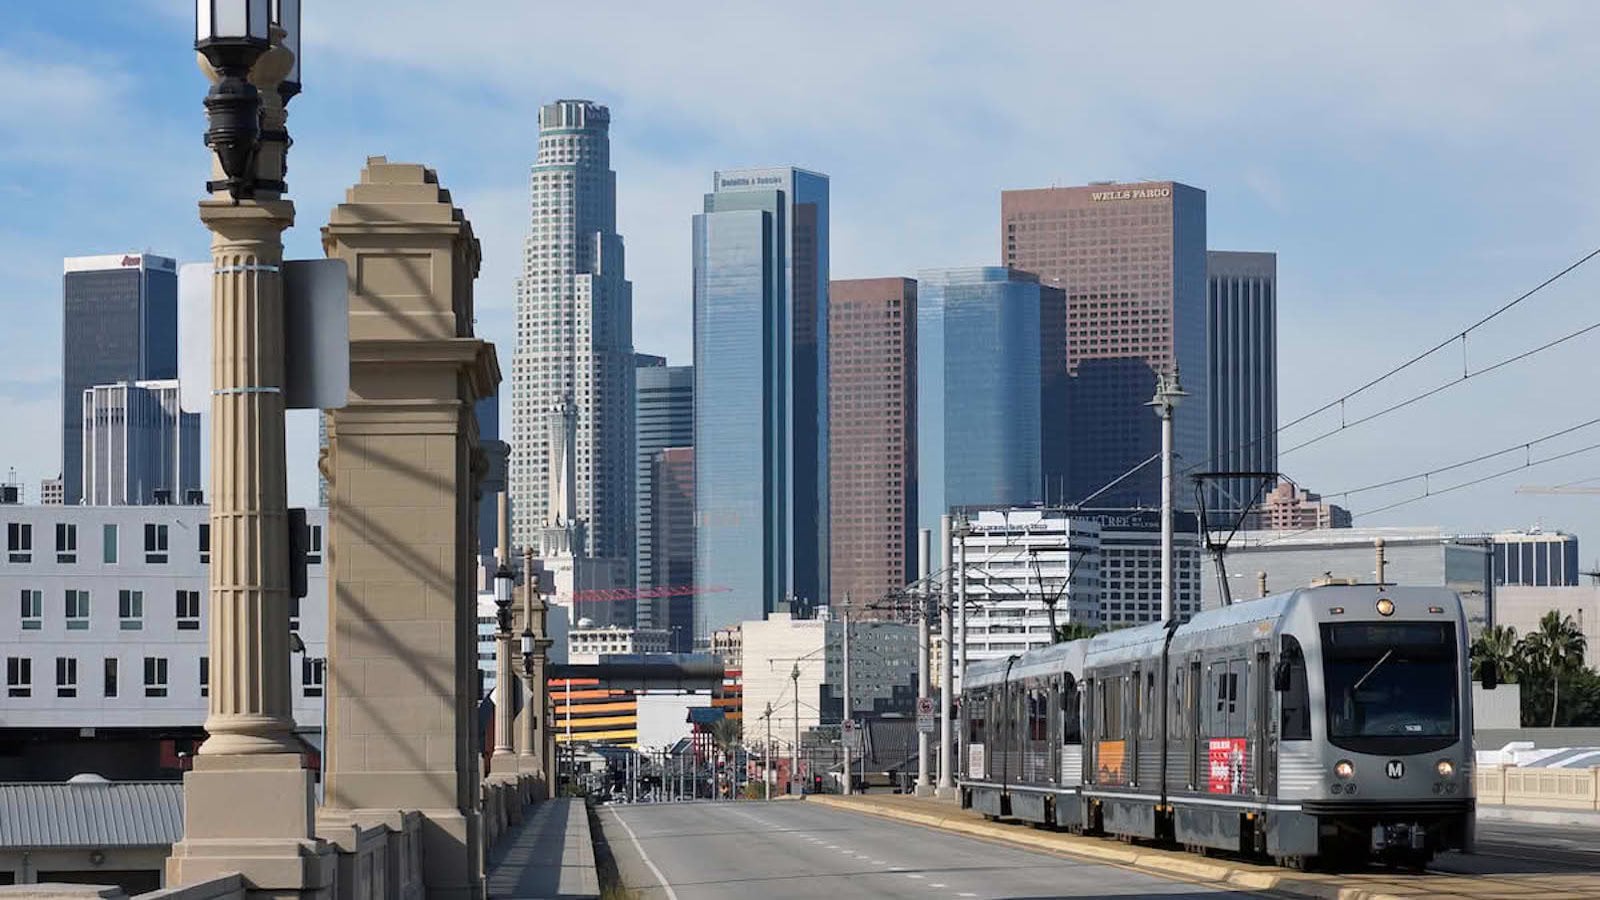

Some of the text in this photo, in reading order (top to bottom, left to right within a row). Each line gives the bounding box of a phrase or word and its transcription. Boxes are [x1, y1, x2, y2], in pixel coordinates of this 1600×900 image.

[1092, 188, 1170, 201] WELLS FARGO
[1388, 762, 1402, 777] M
